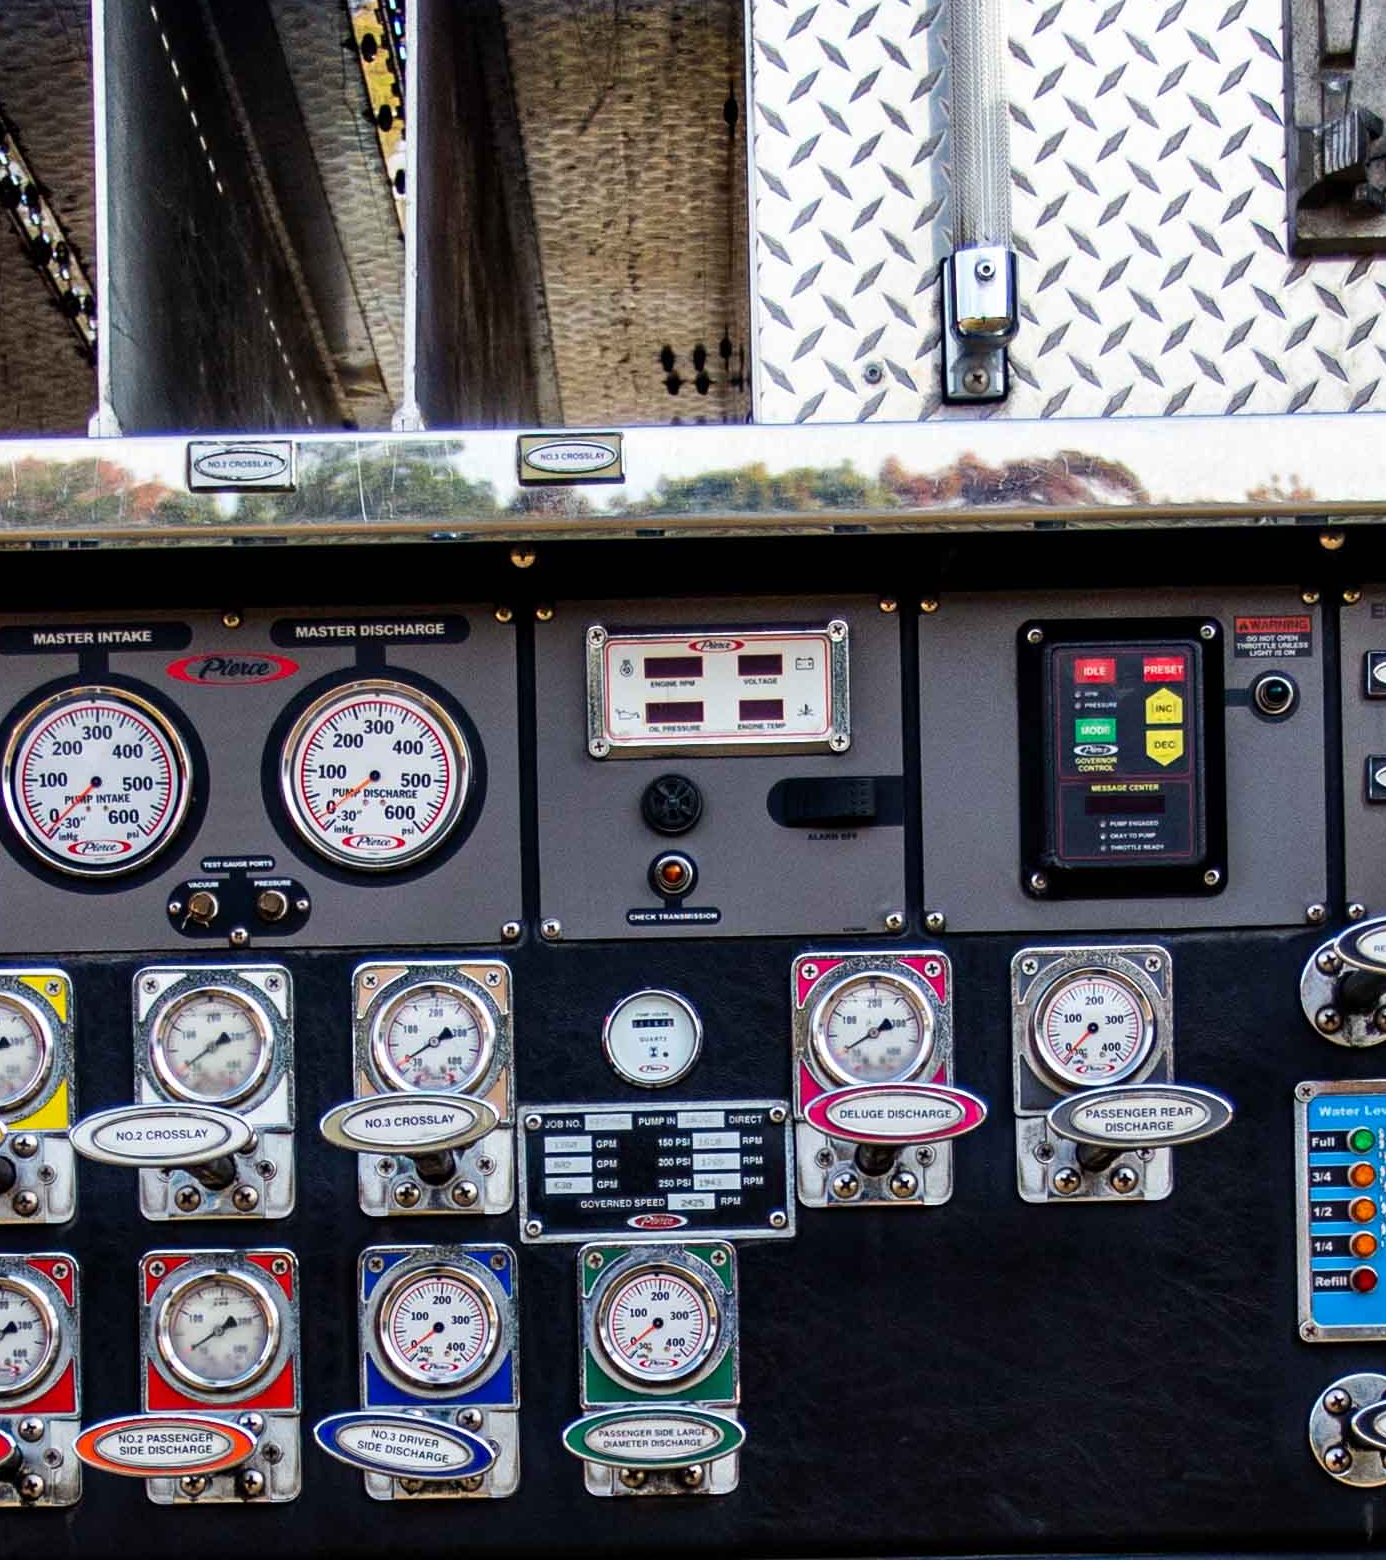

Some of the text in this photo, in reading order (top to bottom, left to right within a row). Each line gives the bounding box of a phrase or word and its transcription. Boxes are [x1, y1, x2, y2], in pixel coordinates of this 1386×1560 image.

[560, 451, 605, 460] CROSSLAY
[228, 458, 274, 469] CROSSLAY
[1248, 619, 1308, 631] WARNING
[296, 623, 445, 638] MASTER DISCHARGE
[33, 631, 152, 645] MASTER INTAKE
[199, 655, 269, 679] Pierce
[1084, 667, 1106, 676] IDLE
[1144, 665, 1183, 675] PRESET
[1155, 704, 1172, 712] INC
[82, 725, 112, 740] 300
[364, 720, 394, 735] 300
[1081, 726, 1110, 735] MODE
[333, 733, 363, 748] 200
[1154, 741, 1175, 749] DEC
[52, 741, 83, 756] 200
[112, 744, 143, 759] 400
[392, 740, 423, 755] 400
[318, 764, 347, 779] 100
[39, 772, 67, 787] 100
[123, 777, 153, 791] 500
[400, 773, 431, 788] 500
[96, 793, 130, 803] INTAKE
[363, 788, 417, 799] DISCHARGE
[326, 800, 336, 814] 0
[49, 808, 60, 824] 0
[108, 810, 139, 825] 600
[384, 805, 415, 820] 600
[127, 829, 140, 840] psi
[334, 825, 354, 835] inHg
[401, 825, 414, 836] psi
[58, 832, 78, 842] inHg
[357, 836, 391, 848] Pierce
[82, 841, 117, 853] Pierce
[203, 861, 221, 869] TEST
[223, 860, 247, 868] GAUGE
[628, 911, 718, 922] CHECK TRANSMISSION
[1085, 996, 1103, 1006] 200
[429, 1008, 444, 1018] 200
[1064, 1014, 1082, 1023] 100
[1105, 1015, 1124, 1025] 300
[404, 1025, 419, 1034] 100
[1101, 1042, 1121, 1052] 400
[839, 1109, 952, 1119] DELUGE DISCHARGE
[1086, 1107, 1193, 1119] PASSENGER REAR
[1319, 1105, 1360, 1117] Water
[365, 1114, 456, 1129] NO.3 CROSSLAY
[545, 1120, 563, 1129] JOB
[565, 1119, 581, 1128] NO.
[638, 1117, 664, 1126] PUMP
[667, 1117, 676, 1125] IN
[729, 1116, 762, 1125] DIRECT
[1105, 1122, 1173, 1133] DISCHARGE
[117, 1129, 208, 1141] NO.2 CROSSLAY
[596, 1140, 617, 1149] GPM
[658, 1138, 673, 1147] 150
[676, 1138, 690, 1146] PSI
[742, 1137, 762, 1145] RPM
[1311, 1136, 1335, 1148] Full
[596, 1160, 617, 1168] GPM
[658, 1158, 674, 1167] 200
[676, 1158, 691, 1166] PSI
[743, 1156, 763, 1165] RPM
[743, 1177, 764, 1186] RPM
[1312, 1171, 1332, 1183] 3/4
[597, 1180, 618, 1189] GPM
[659, 1179, 674, 1188] 250
[677, 1179, 691, 1187] PSI
[581, 1199, 665, 1209] GOVERNED SPEED
[720, 1197, 741, 1205] RPM
[1313, 1206, 1332, 1217] 1/2
[1314, 1241, 1333, 1252] 1/4
[1314, 1275, 1348, 1287] Refill
[432, 1295, 452, 1305] 200
[651, 1291, 669, 1301] 200
[411, 1311, 429, 1321] 100
[630, 1308, 647, 1317] 100
[670, 1311, 689, 1321] 300
[451, 1315, 470, 1325] 300
[446, 1342, 465, 1352] 400
[666, 1338, 685, 1347] 400
[599, 1428, 706, 1437] PASSENGER SIDE LARGE
[119, 1432, 213, 1444] NO.2 PASSENGER
[371, 1429, 439, 1448] NO.3 DRIVER
[604, 1438, 702, 1448] DIAMETER DISCHARGE
[119, 1445, 213, 1455] SIDE DISCHARGE
[357, 1440, 449, 1463] SIDE DISCHARGE
